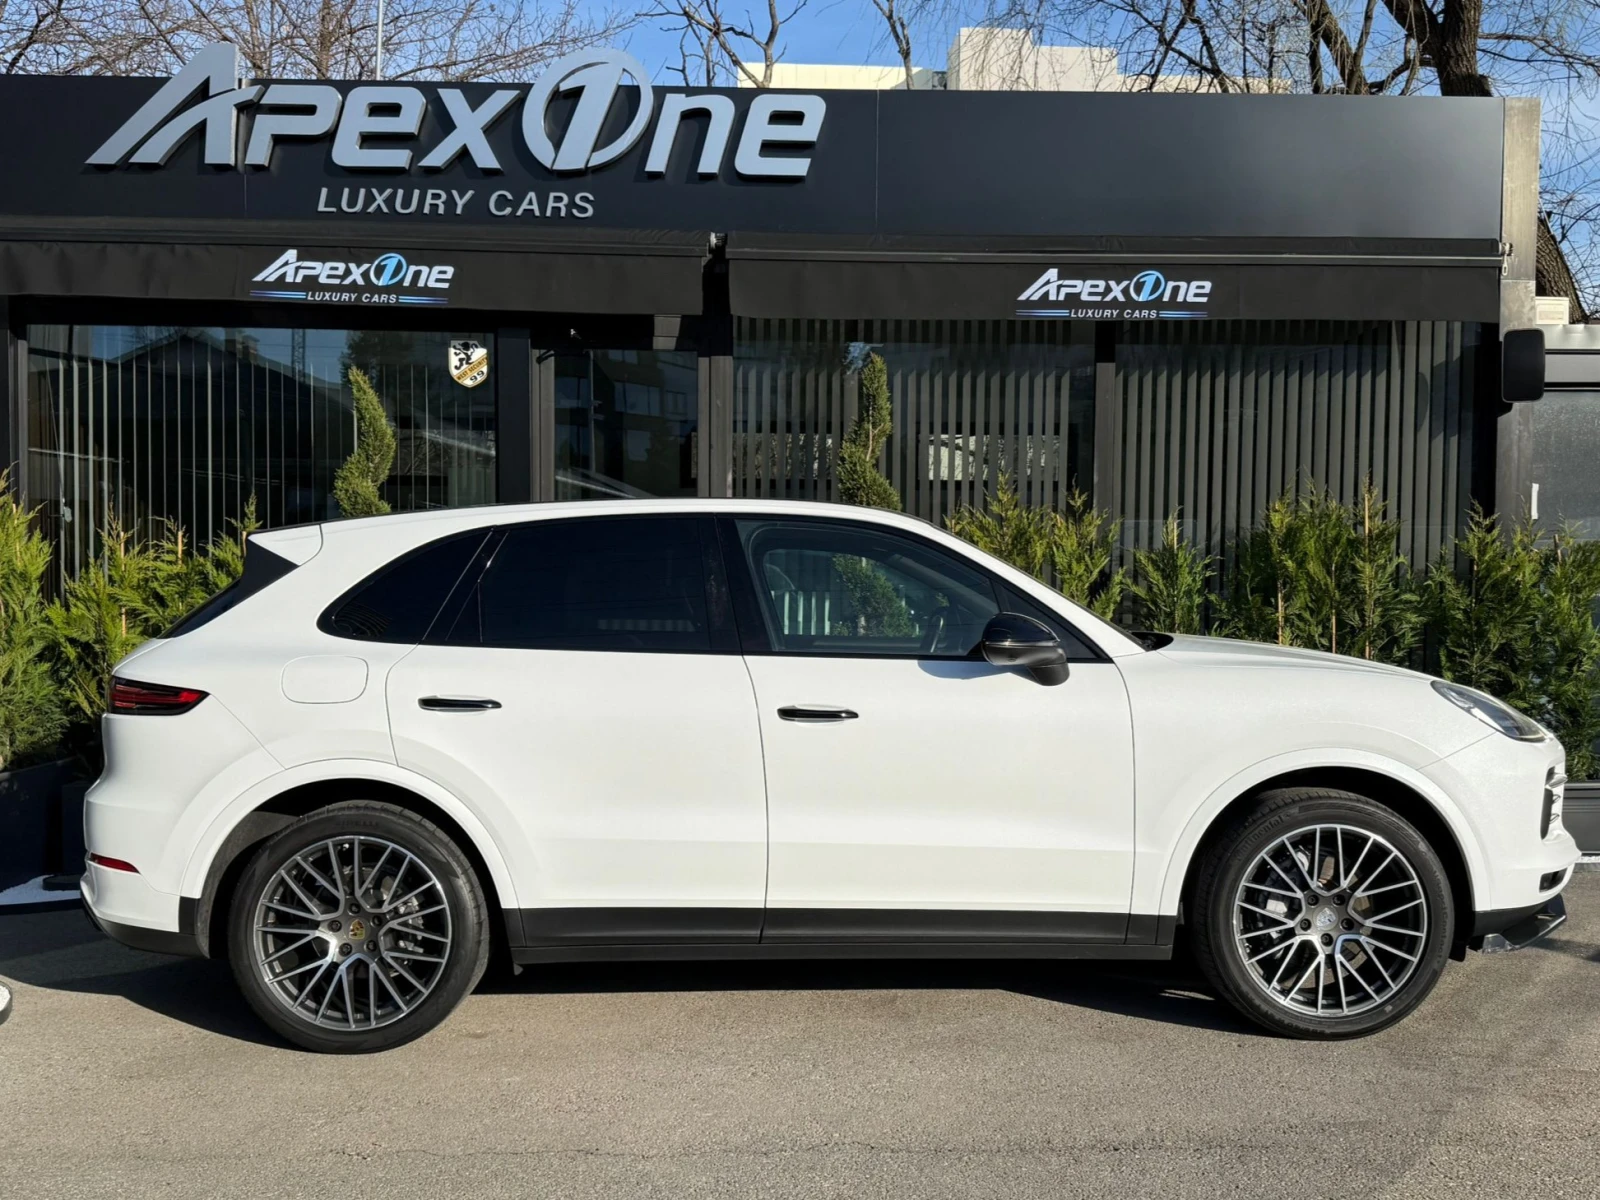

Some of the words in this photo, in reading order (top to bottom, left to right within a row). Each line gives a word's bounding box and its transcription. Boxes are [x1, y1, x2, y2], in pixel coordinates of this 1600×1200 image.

[317, 187, 476, 216] LUXURY
[488, 190, 596, 219] CARS
[307, 291, 358, 302] LUXURY
[361, 293, 398, 304] CARS
[1070, 308, 1120, 319] LUXURY
[1123, 309, 1158, 319] CARS
[457, 370, 469, 380] WEST
[468, 357, 488, 372] SECURITY
[469, 370, 485, 383] 99
